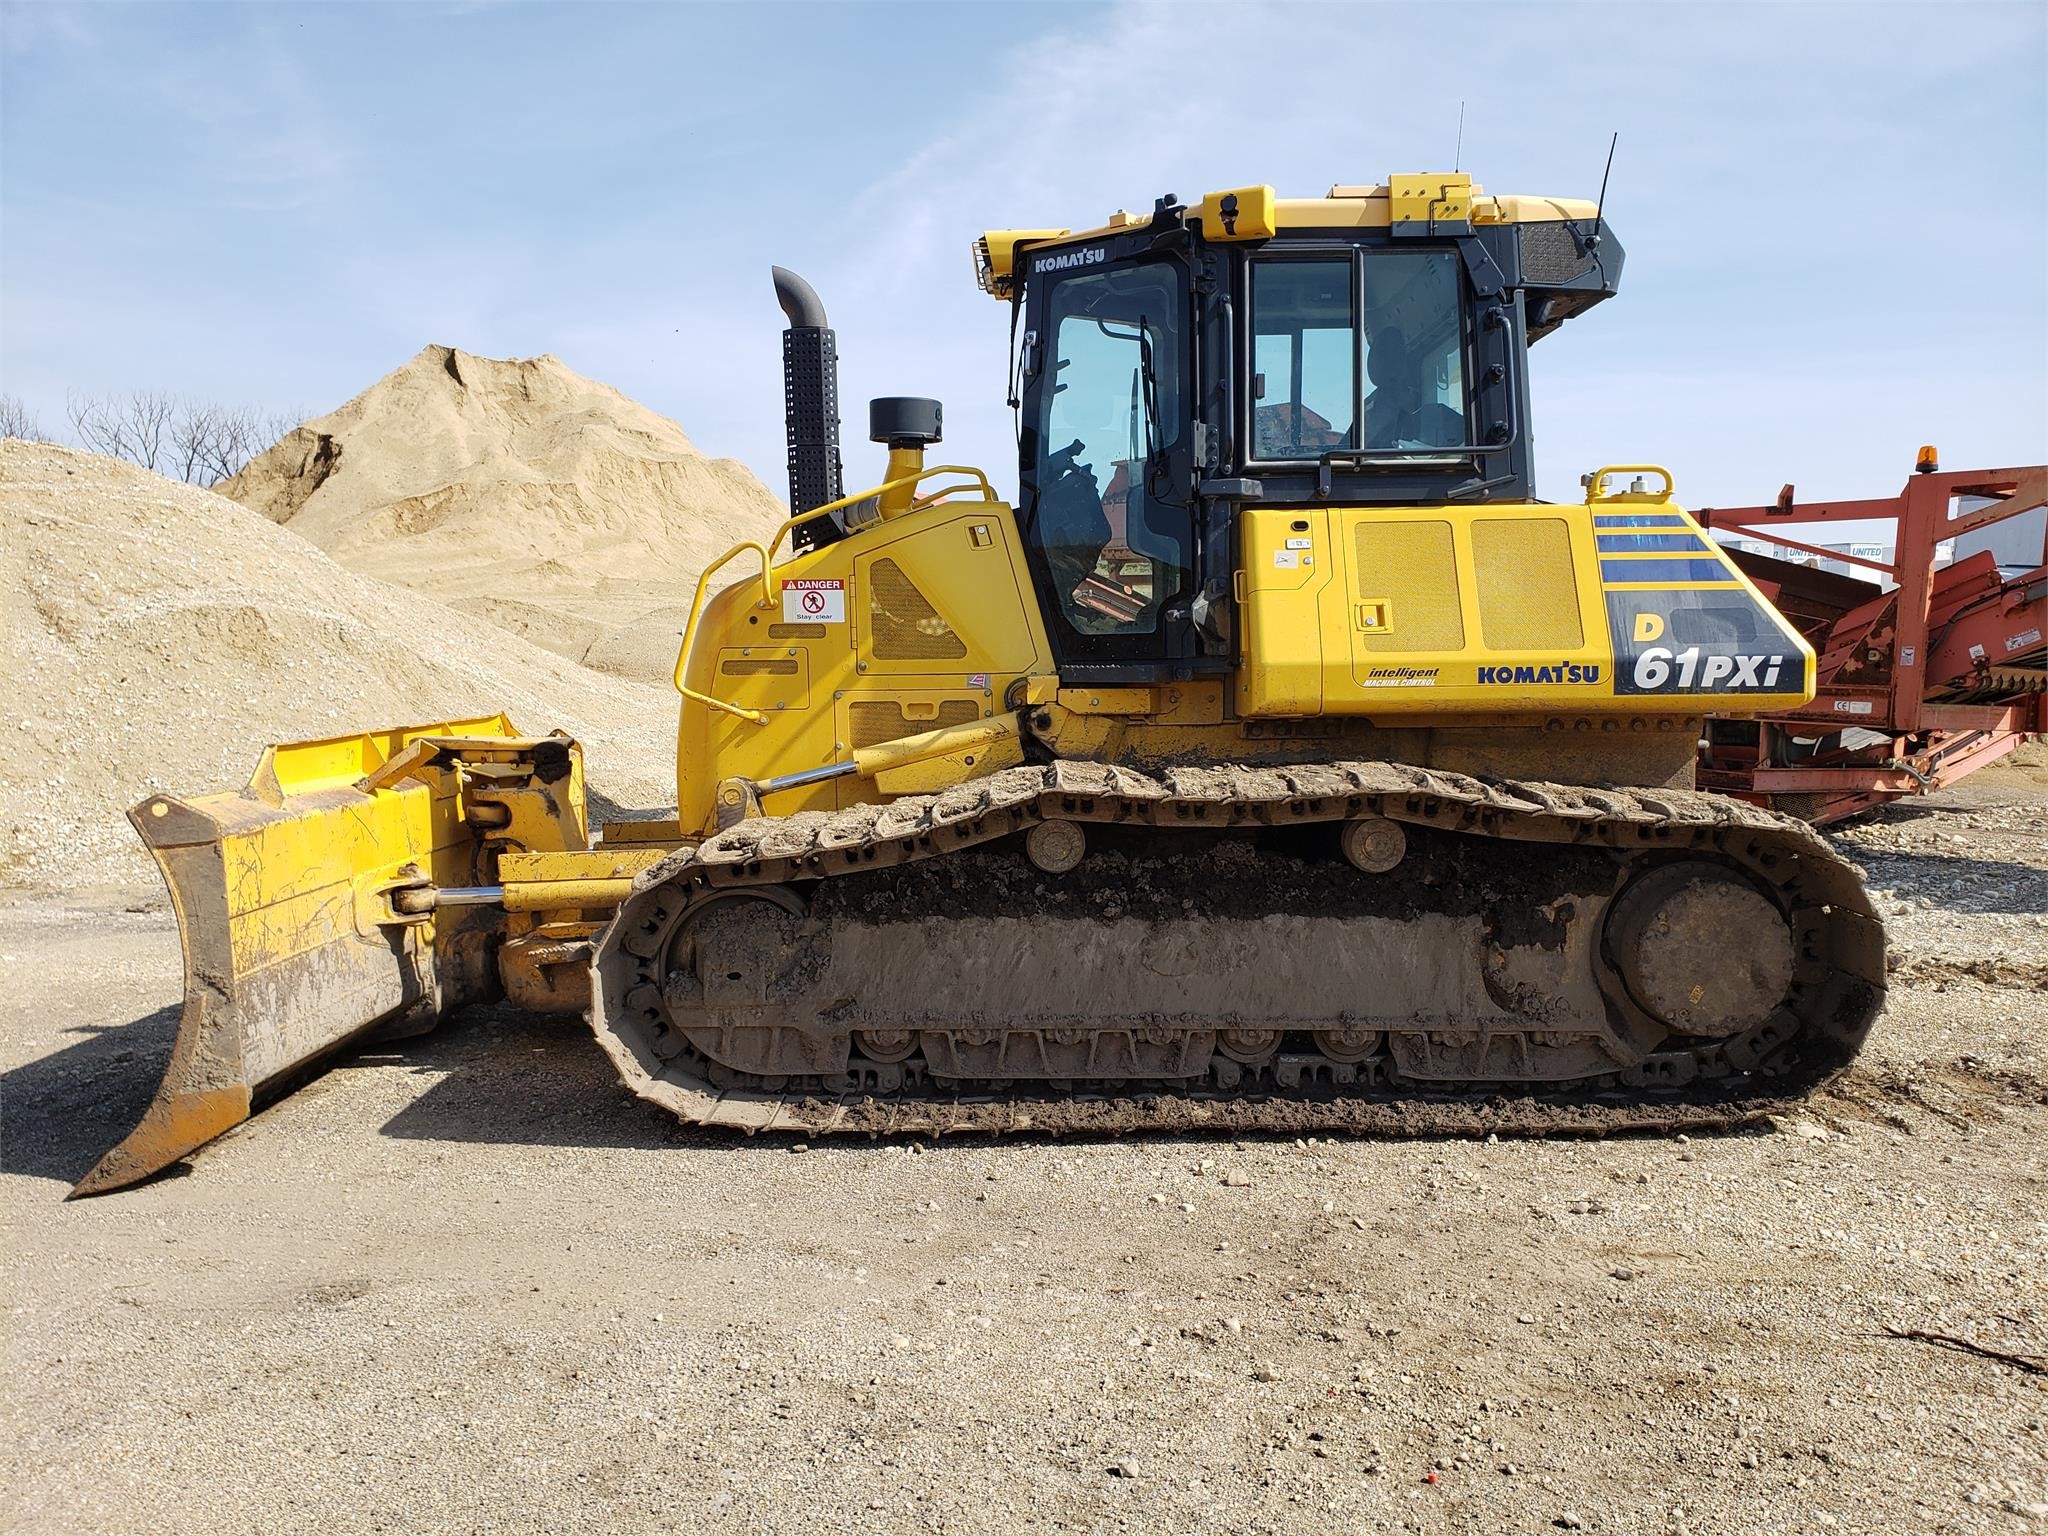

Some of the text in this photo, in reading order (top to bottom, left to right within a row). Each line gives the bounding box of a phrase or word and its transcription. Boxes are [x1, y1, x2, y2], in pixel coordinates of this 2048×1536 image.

[1035, 248, 1105, 273] KOMATSU
[1852, 547, 1882, 557] UNITED
[797, 580, 840, 589] DANGER
[1633, 613, 1665, 642] D
[1368, 667, 1440, 680] intelligent
[1477, 660, 1600, 684] KOMATSU
[1363, 678, 1436, 687] MACHINE CONTROL
